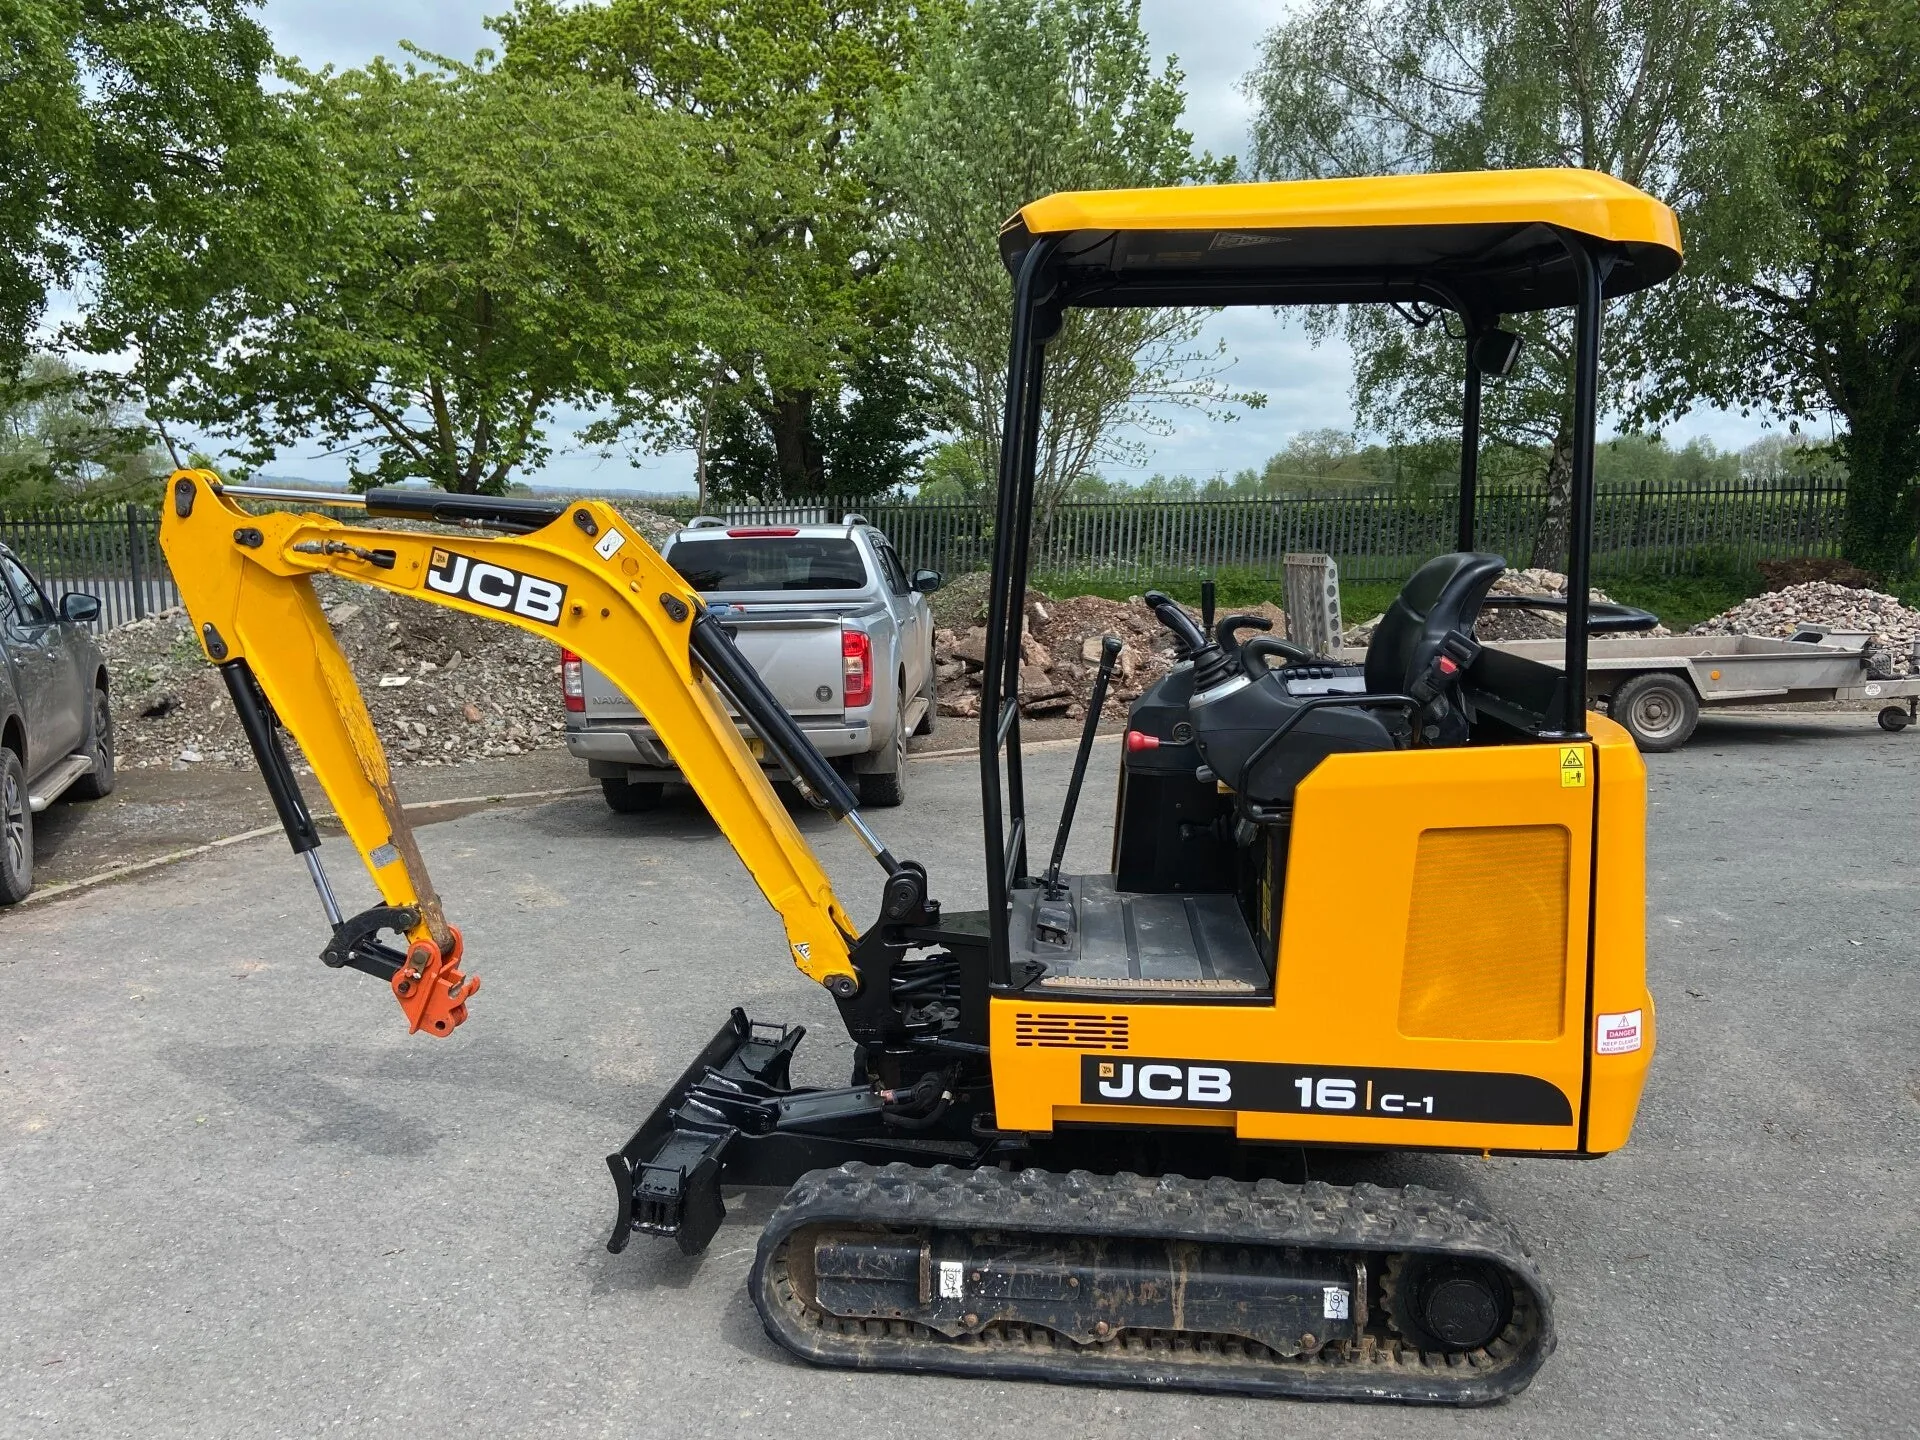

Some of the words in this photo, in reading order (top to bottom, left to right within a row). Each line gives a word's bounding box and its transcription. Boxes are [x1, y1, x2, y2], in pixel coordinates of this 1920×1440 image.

[428, 556, 563, 622] JCB
[592, 695, 629, 705] NAVA
[1609, 1029, 1635, 1038] DANGER
[1099, 1063, 1232, 1103] JCB
[1294, 1077, 1357, 1110] 16
